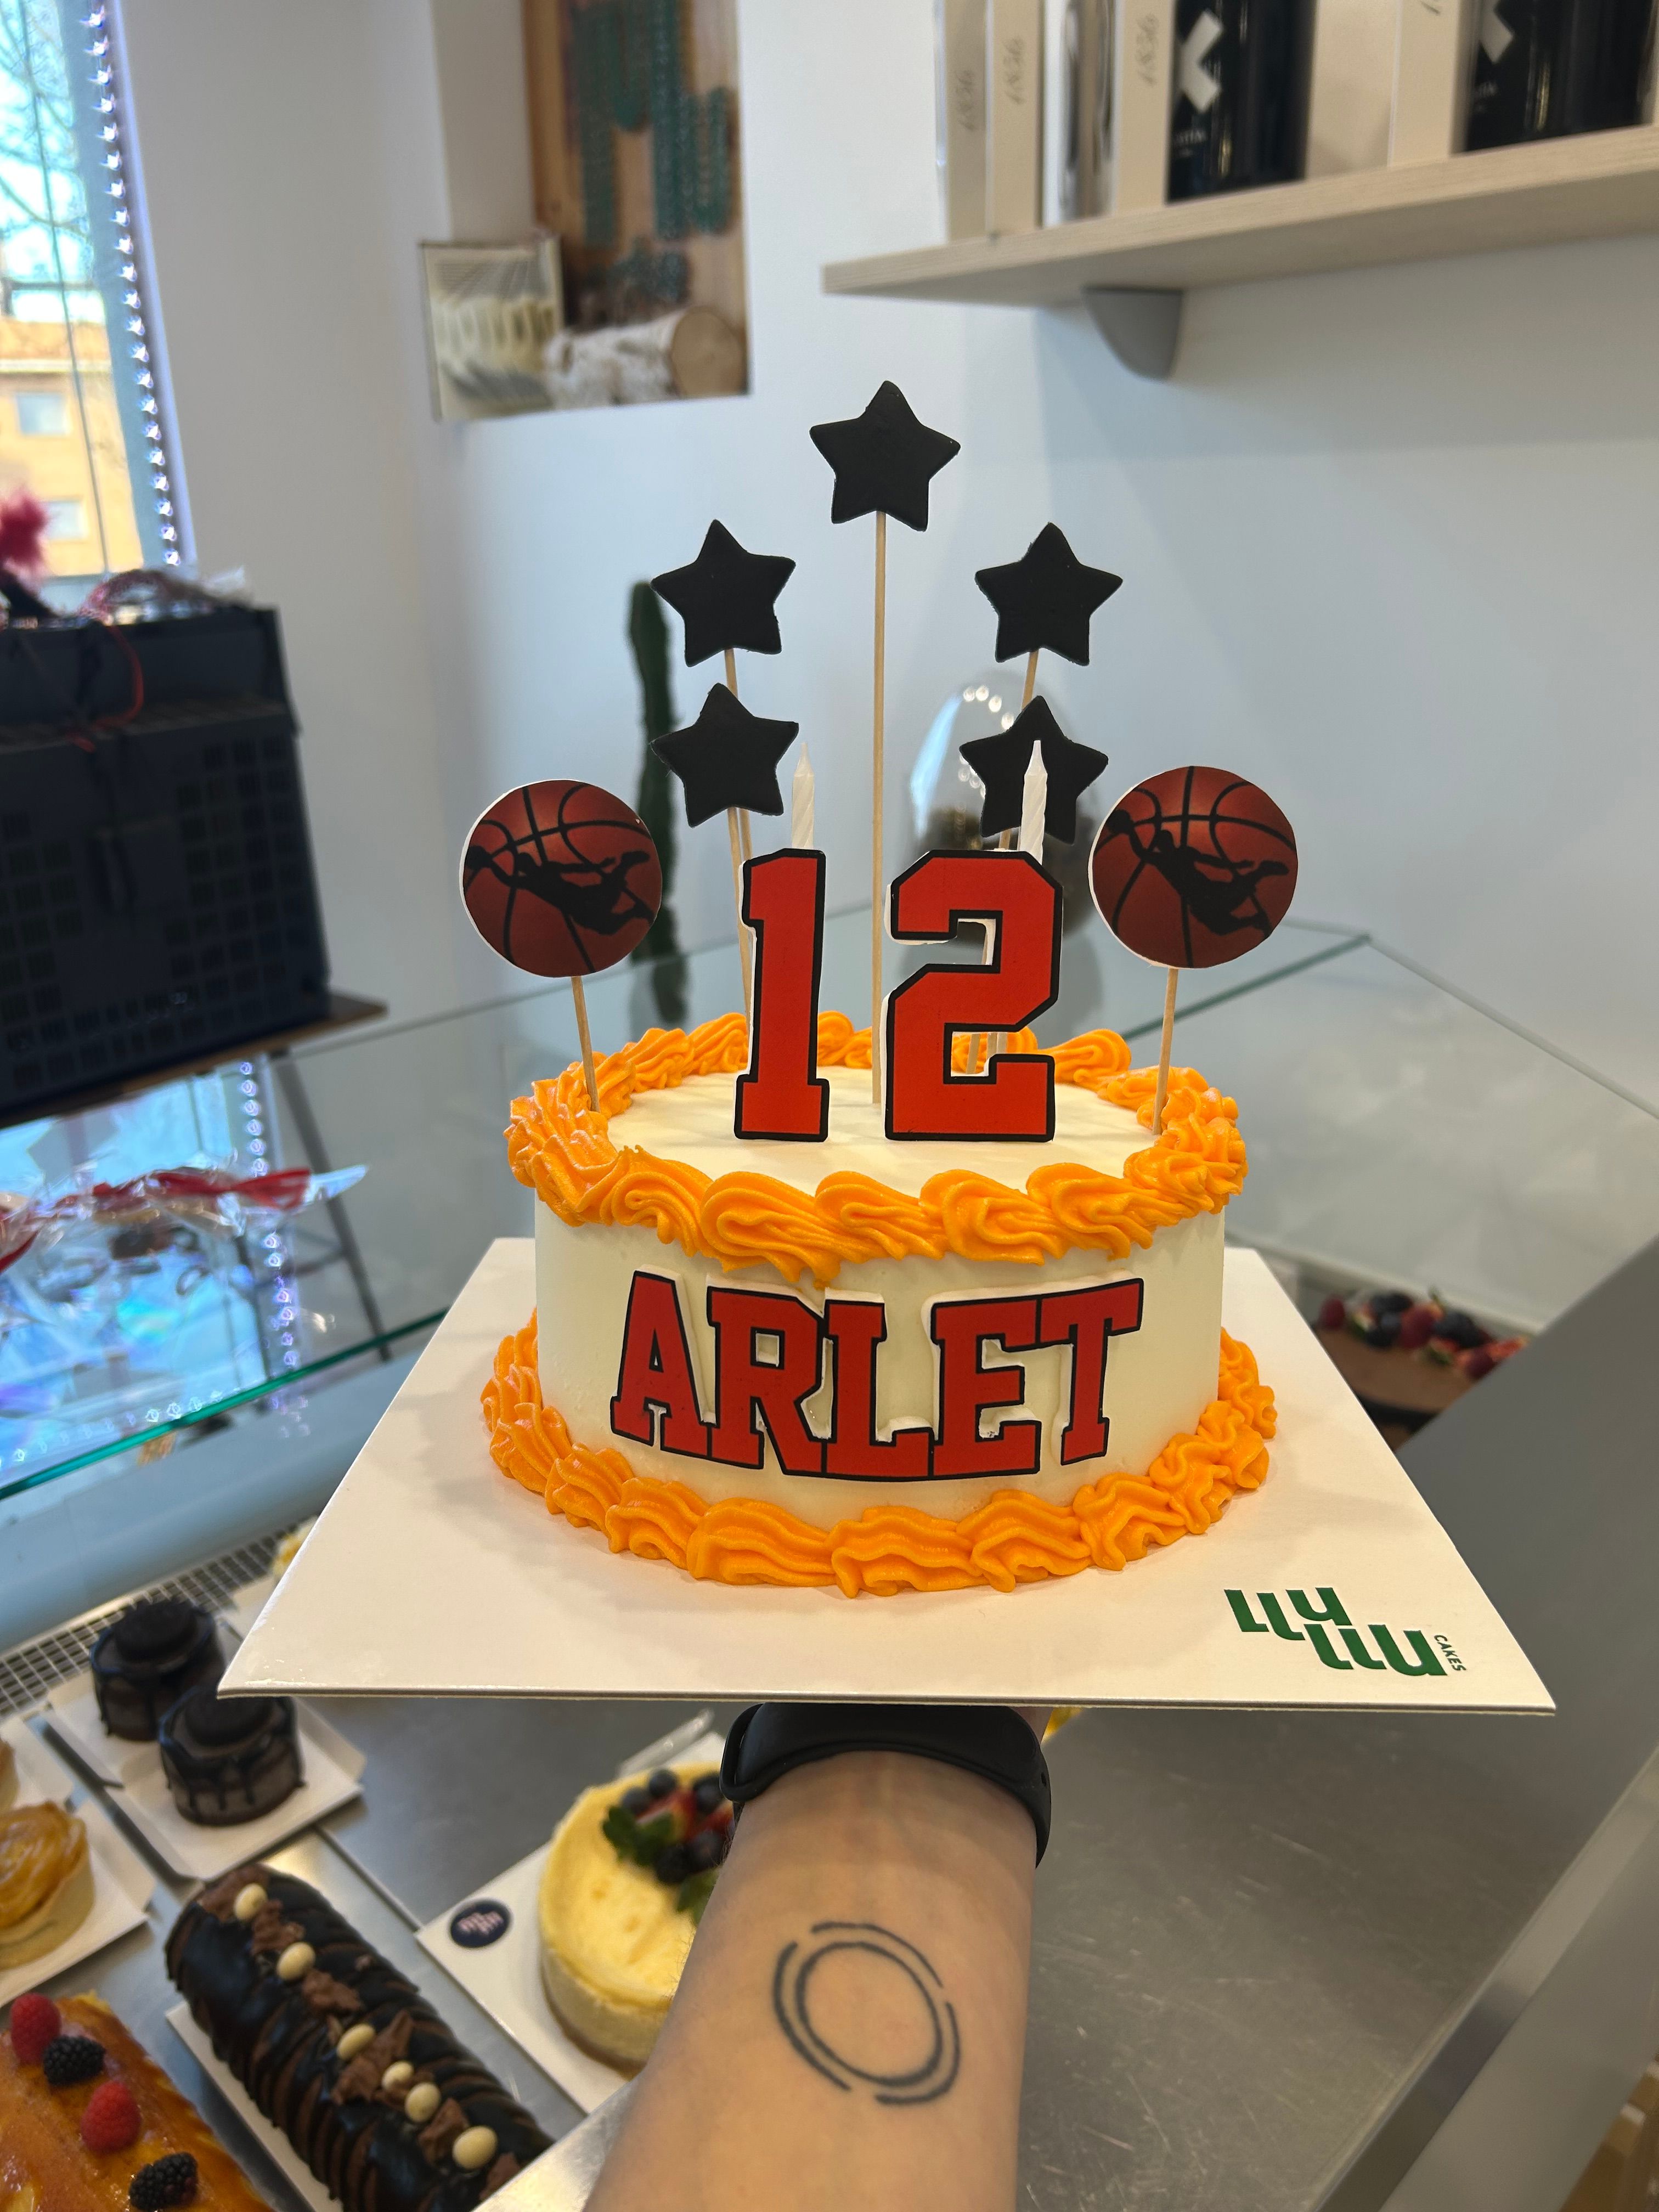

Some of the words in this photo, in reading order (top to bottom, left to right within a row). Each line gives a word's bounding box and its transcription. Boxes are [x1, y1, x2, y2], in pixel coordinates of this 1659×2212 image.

[734, 848, 1063, 1142] 12
[610, 1269, 1144, 1482] ARLET
[1434, 1634, 1466, 1672] CAKES
